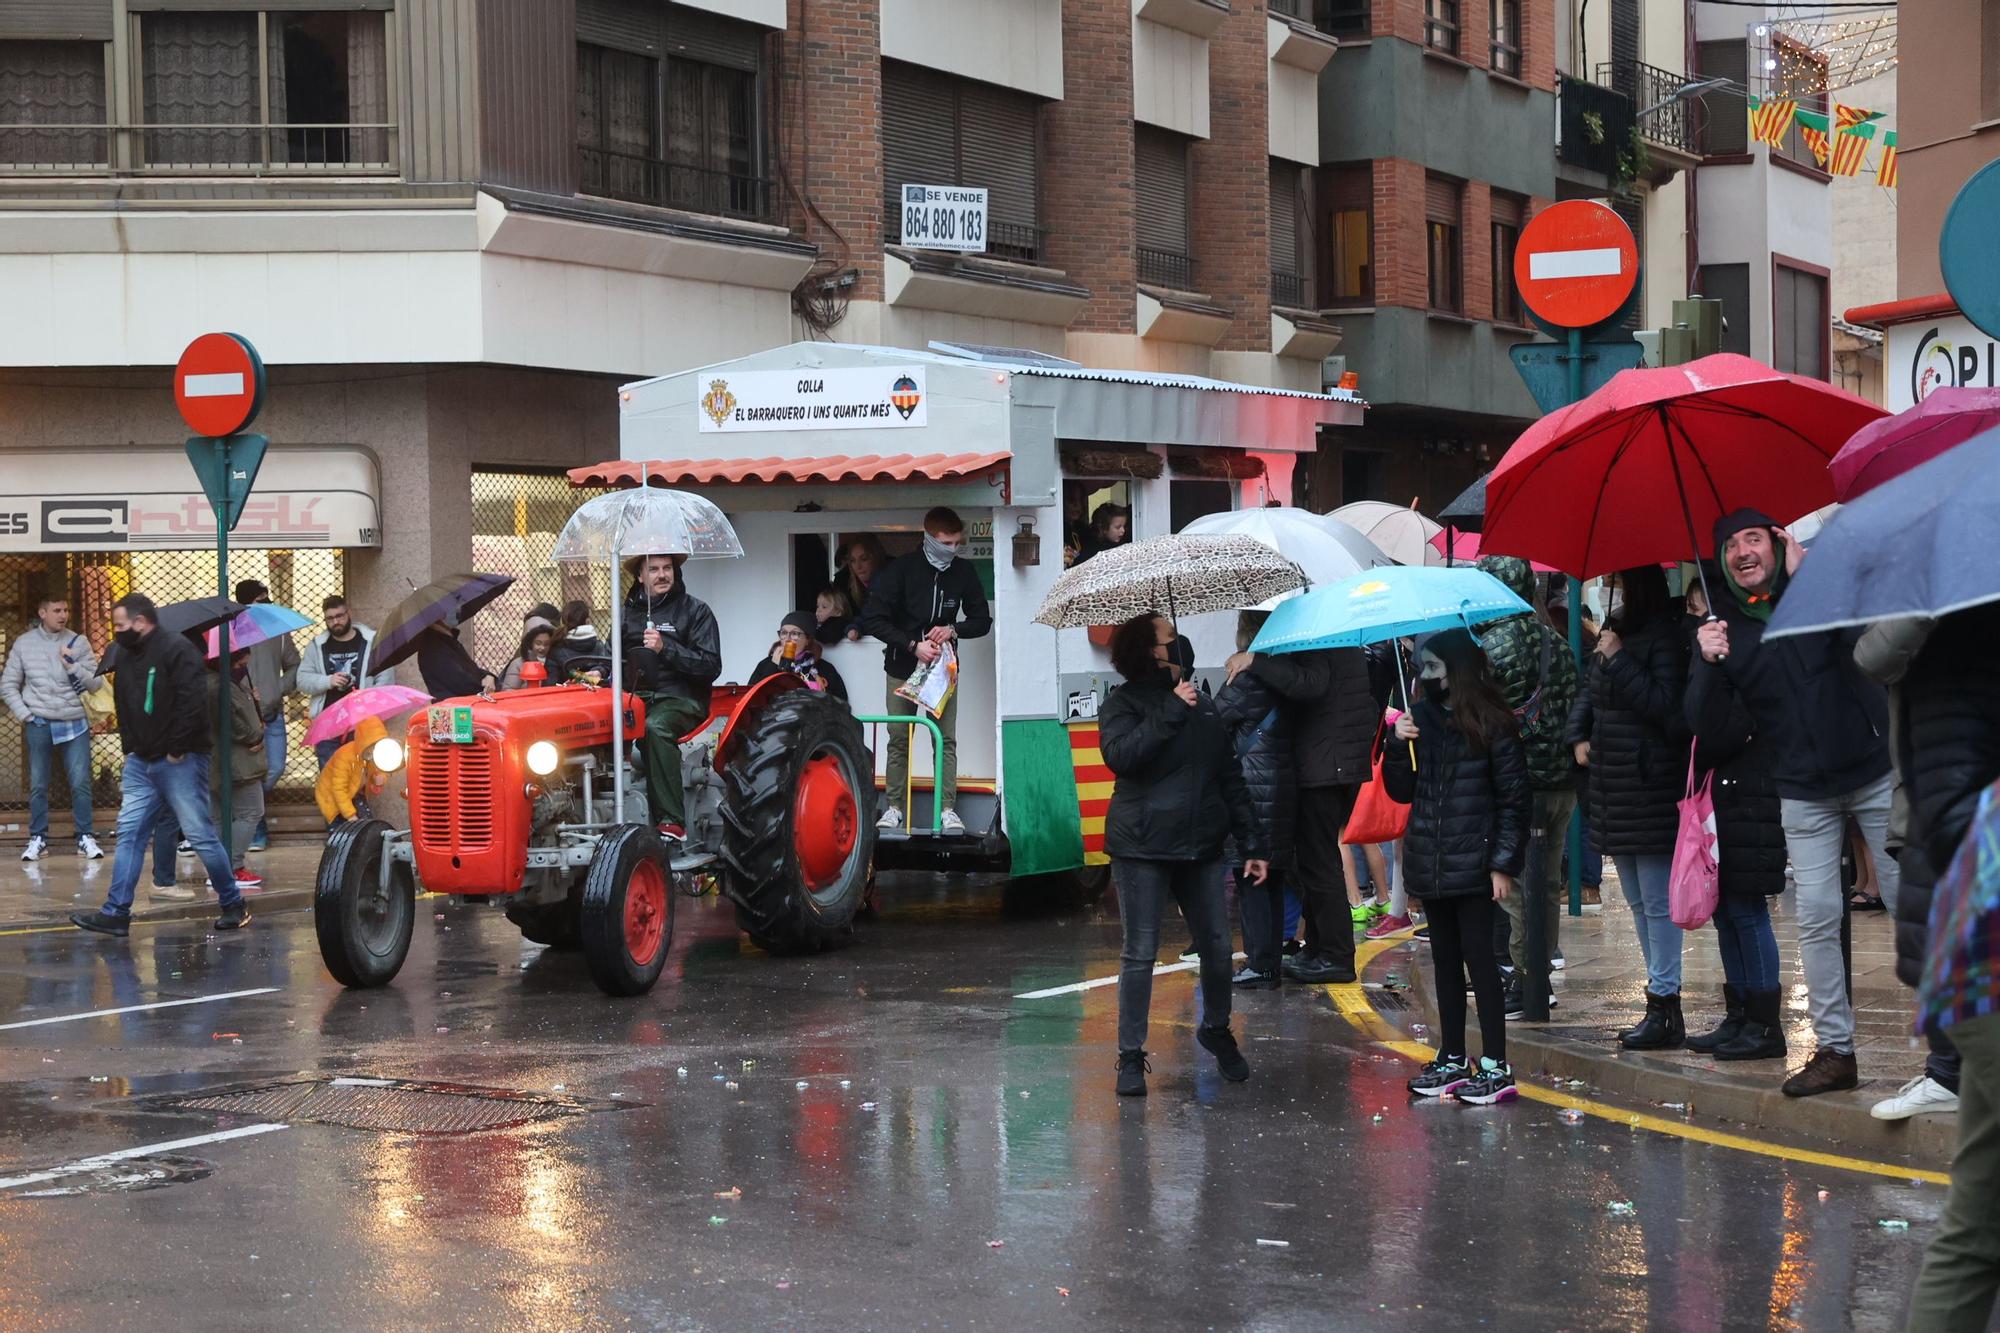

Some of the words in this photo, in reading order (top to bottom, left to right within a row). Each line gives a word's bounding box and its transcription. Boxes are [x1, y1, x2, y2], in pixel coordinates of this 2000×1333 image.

[926, 190, 941, 201] SE
[944, 192, 983, 203] VENDE
[906, 206, 929, 238] 864
[932, 207, 955, 240] 880
[959, 209, 982, 242] 183
[905, 241, 982, 250] www.elitehomecs.com
[797, 379, 824, 393] COLLA
[735, 407, 746, 422] EL
[747, 406, 805, 421] BARRAQUERO
[806, 406, 811, 419] I
[813, 405, 831, 419] UNS
[833, 404, 868, 420] QUANTS
[870, 400, 891, 417] MÉS
